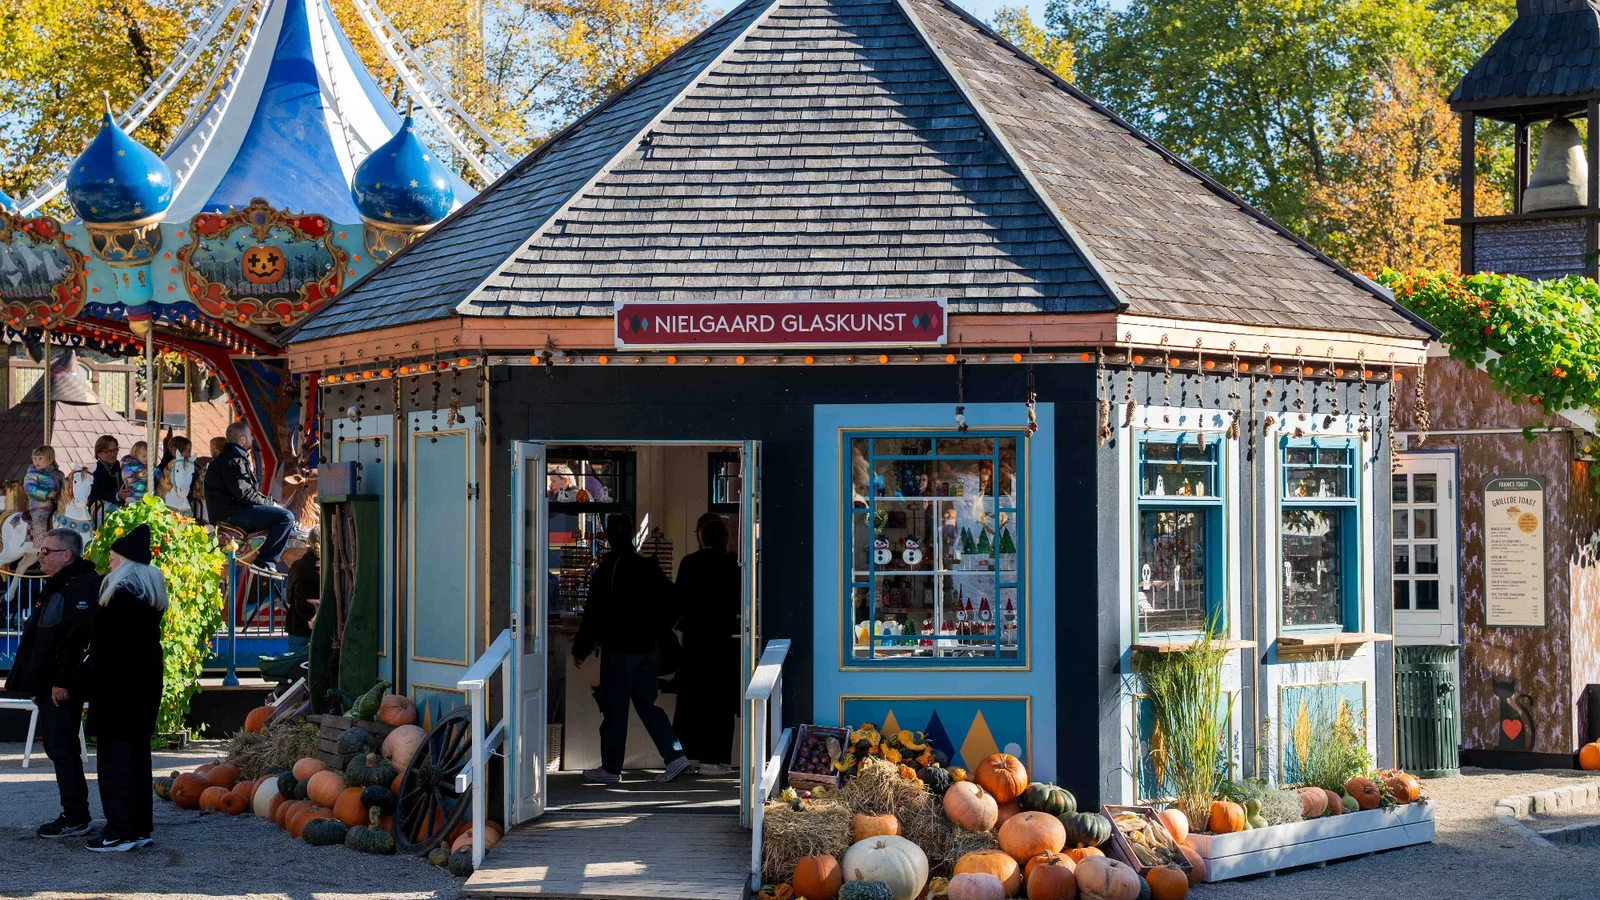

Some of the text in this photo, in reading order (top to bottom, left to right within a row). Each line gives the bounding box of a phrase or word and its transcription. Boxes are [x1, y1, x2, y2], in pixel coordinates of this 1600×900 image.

[655, 312, 907, 334] NIELGAARD GLASKUNST
[1491, 496, 1537, 507] GRILLEDE TOAST
